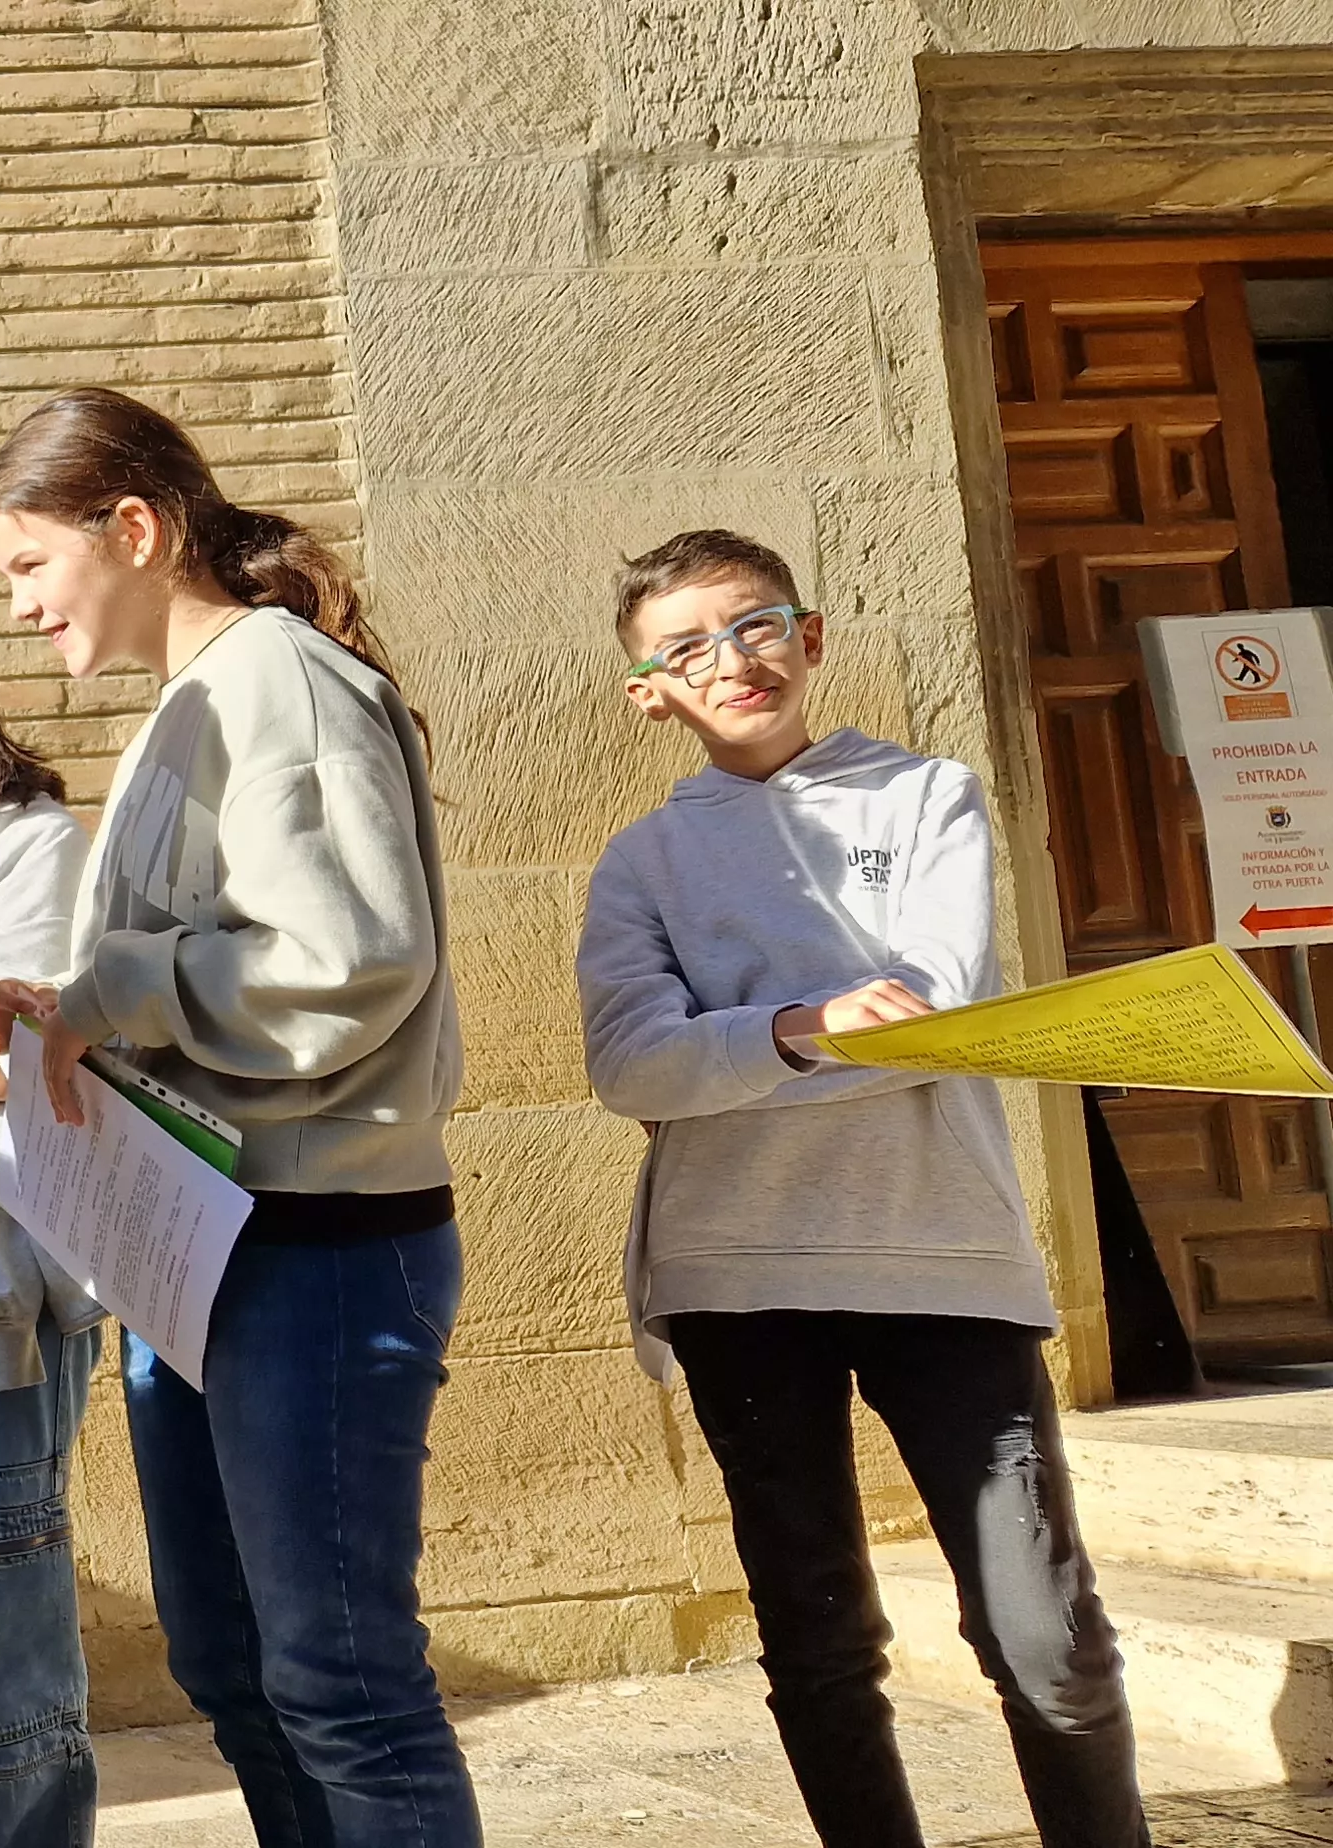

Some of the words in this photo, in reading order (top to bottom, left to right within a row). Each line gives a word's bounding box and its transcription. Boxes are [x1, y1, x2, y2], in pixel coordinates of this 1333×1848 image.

[1212, 742, 1296, 760] PROHIBIDA
[1299, 741, 1318, 755] LA
[1236, 768, 1307, 785] ENTRADA
[1242, 846, 1316, 861] INFORMACIÓN
[1319, 848, 1324, 856] Y
[1242, 864, 1292, 876] ENTRADA
[1294, 863, 1315, 872] POR
[1318, 862, 1330, 871] LA
[1253, 879, 1282, 890] OTRA
[1285, 876, 1324, 887] PUERTA
[981, 1038, 1056, 1059] DERECHO
